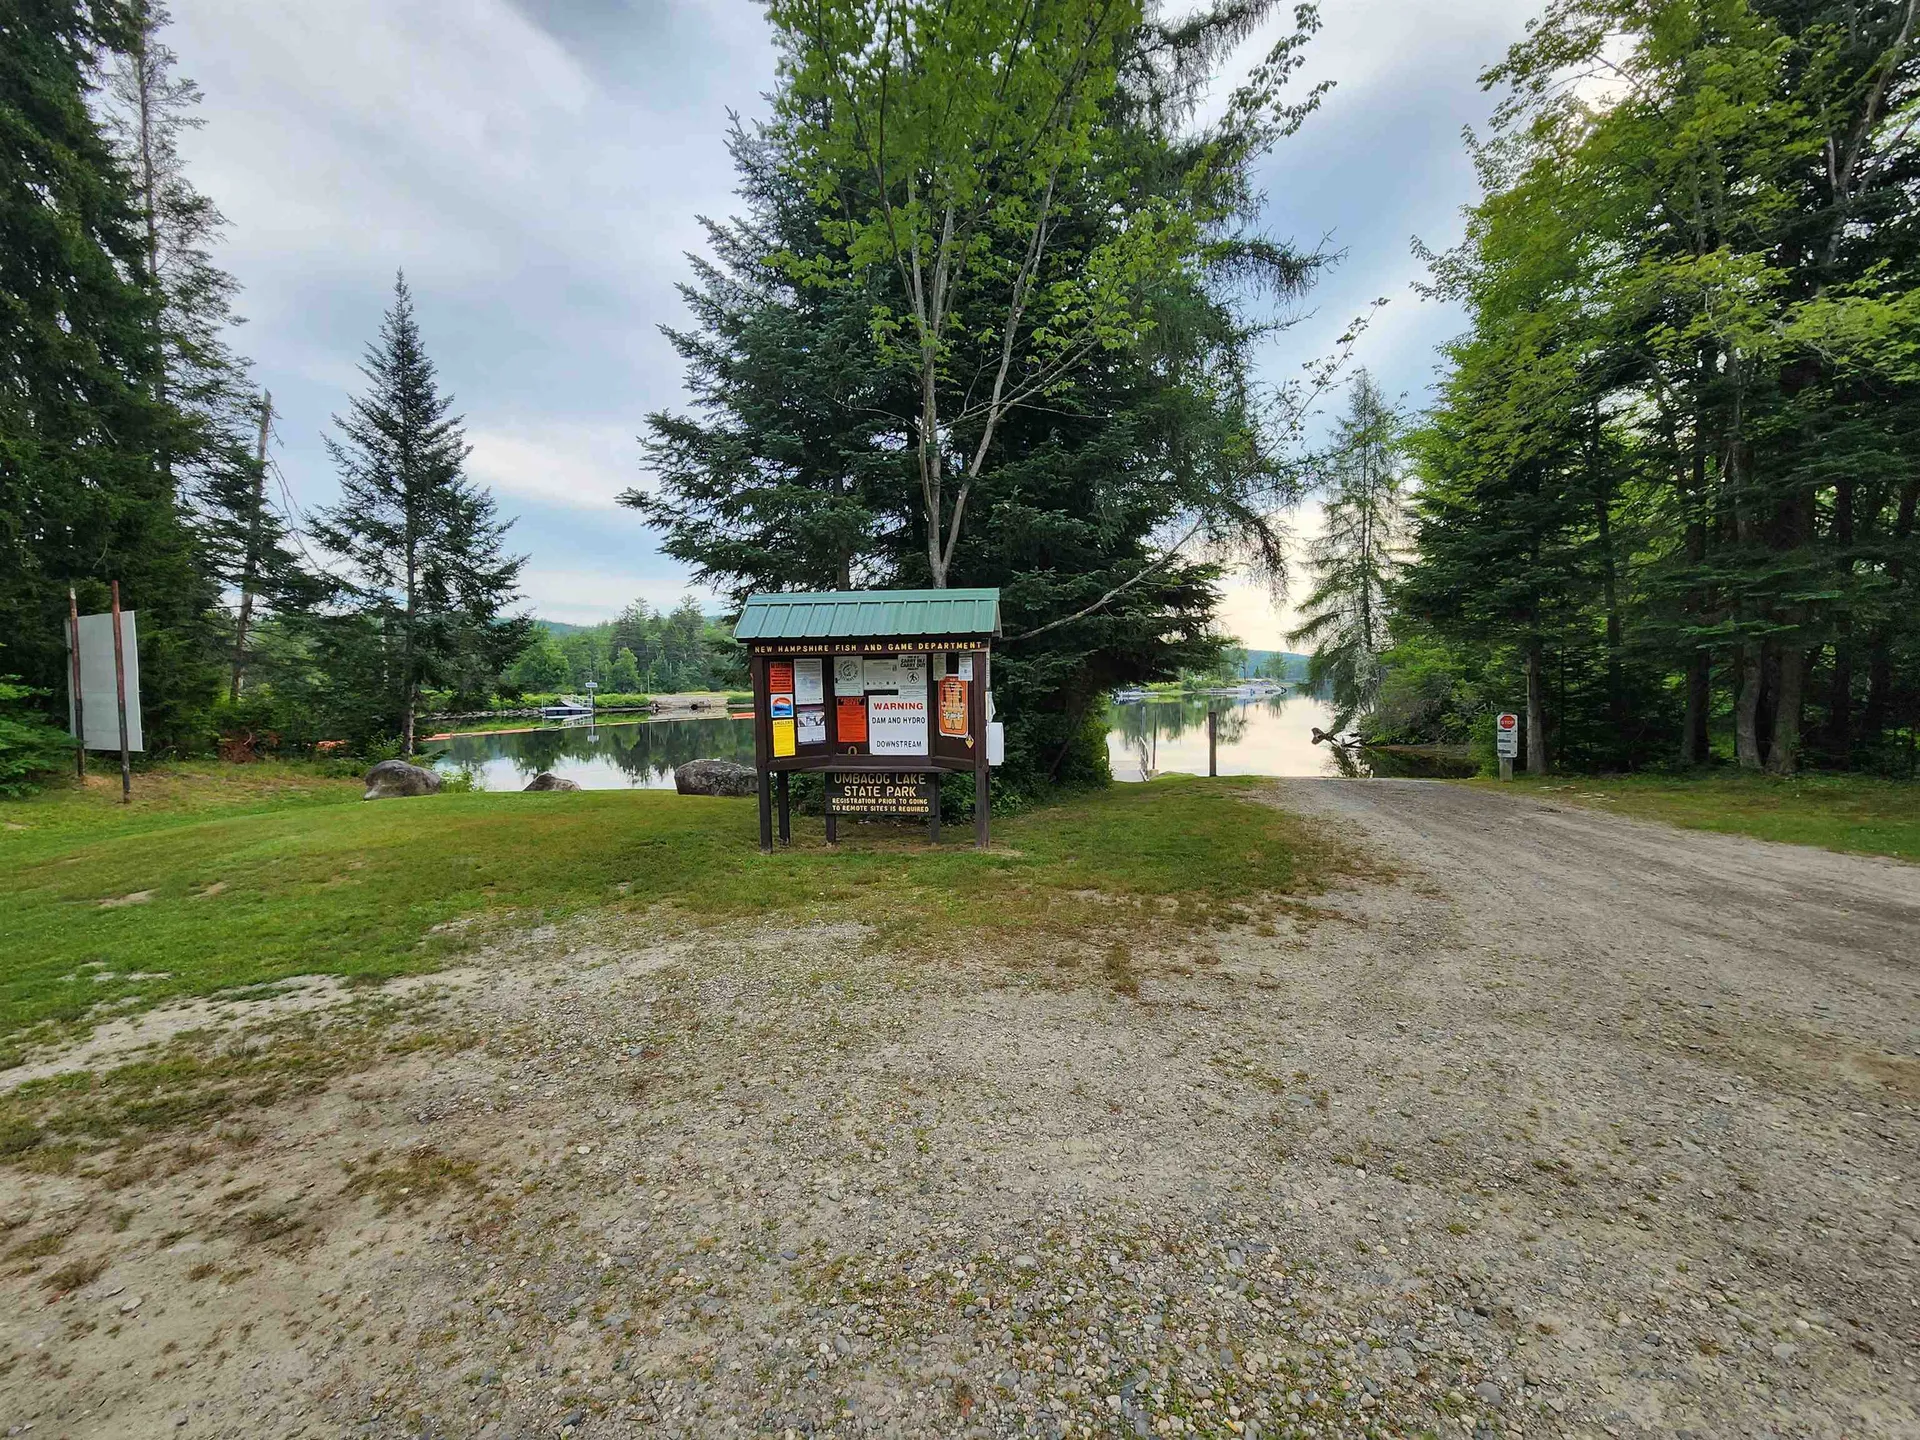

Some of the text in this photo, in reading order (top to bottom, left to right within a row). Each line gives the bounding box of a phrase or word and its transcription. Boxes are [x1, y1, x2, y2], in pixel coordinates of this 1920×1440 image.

[778, 645, 829, 653] HAMPSHIRE
[835, 644, 857, 652] FISH
[864, 643, 882, 651] AND
[888, 643, 913, 651] GAME
[918, 641, 982, 650] DEPARTMENT
[873, 702, 924, 710] WARNING
[871, 716, 926, 724] DAM AND HYDRO
[876, 740, 922, 748] DOWNSTREAM
[834, 773, 927, 785] UMBAGOG LAKE
[844, 785, 917, 797] STATE PARK
